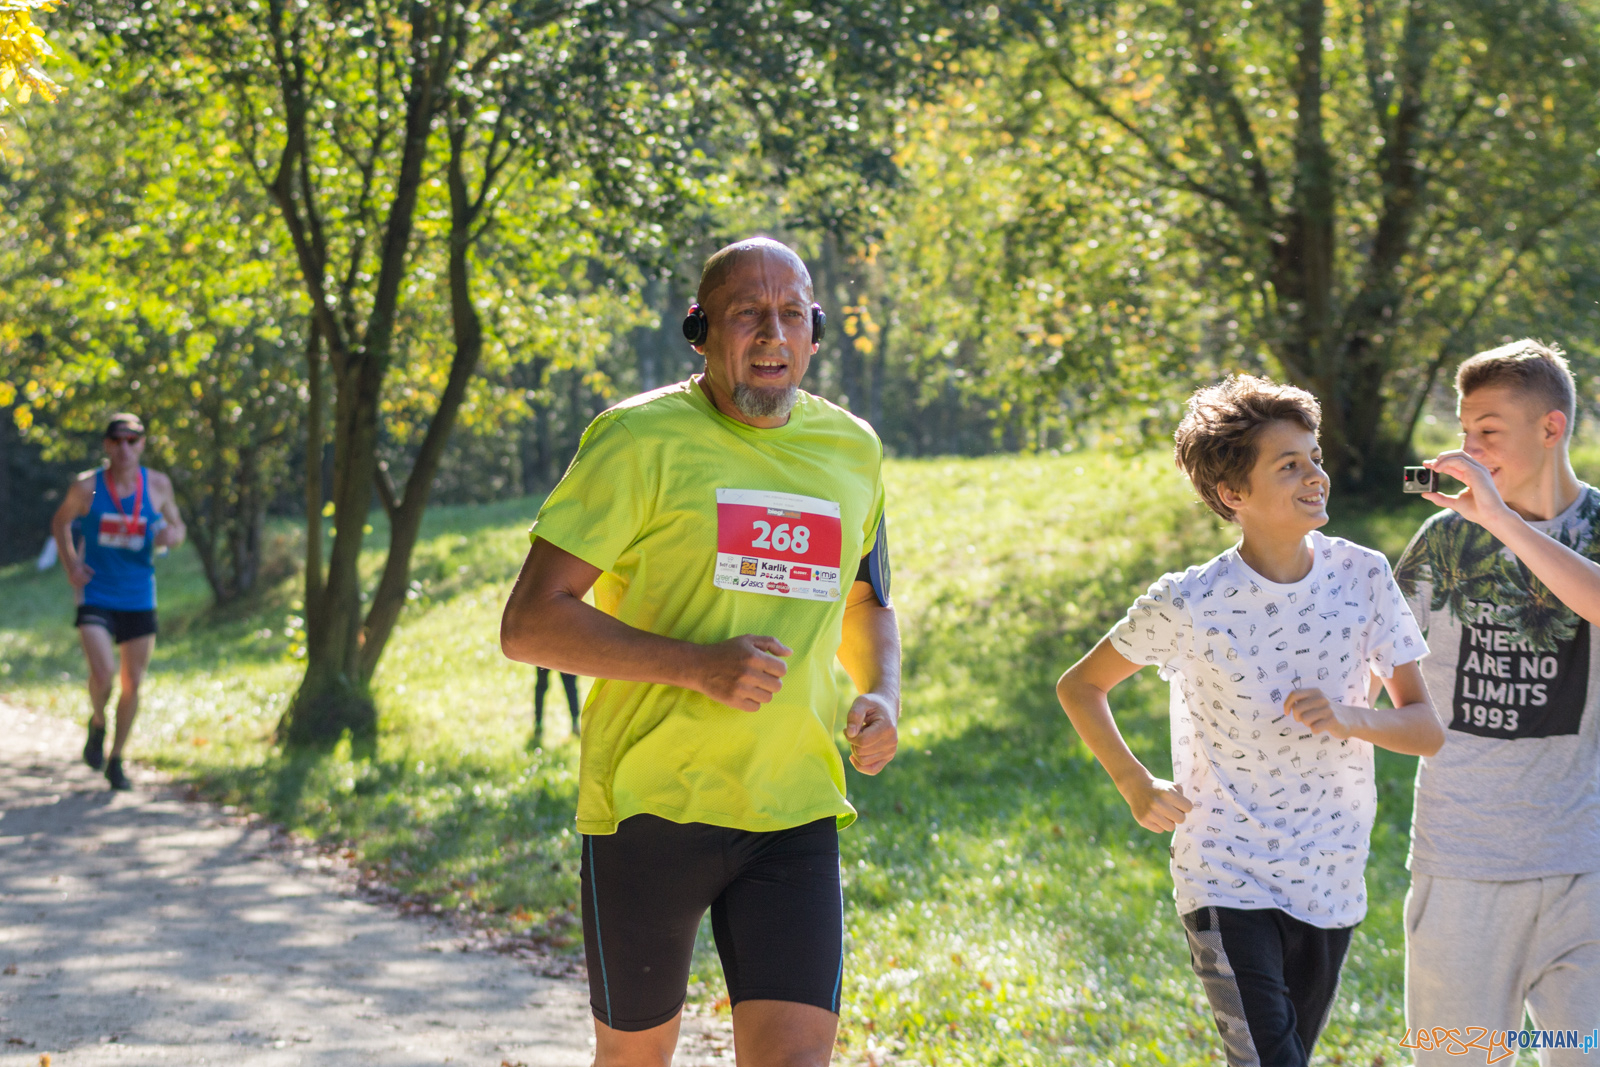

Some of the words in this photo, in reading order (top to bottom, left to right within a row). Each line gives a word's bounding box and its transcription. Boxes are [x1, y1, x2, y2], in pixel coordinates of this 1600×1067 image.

[751, 520, 811, 554] 268
[742, 562, 757, 571] 24
[760, 572, 785, 580] POLAR
[761, 562, 788, 573] Karlik
[821, 571, 837, 580] mjp
[1463, 650, 1512, 678] ARE
[1519, 656, 1558, 679] NO
[1462, 675, 1548, 706] LIMITS
[1461, 702, 1519, 731] 1993
